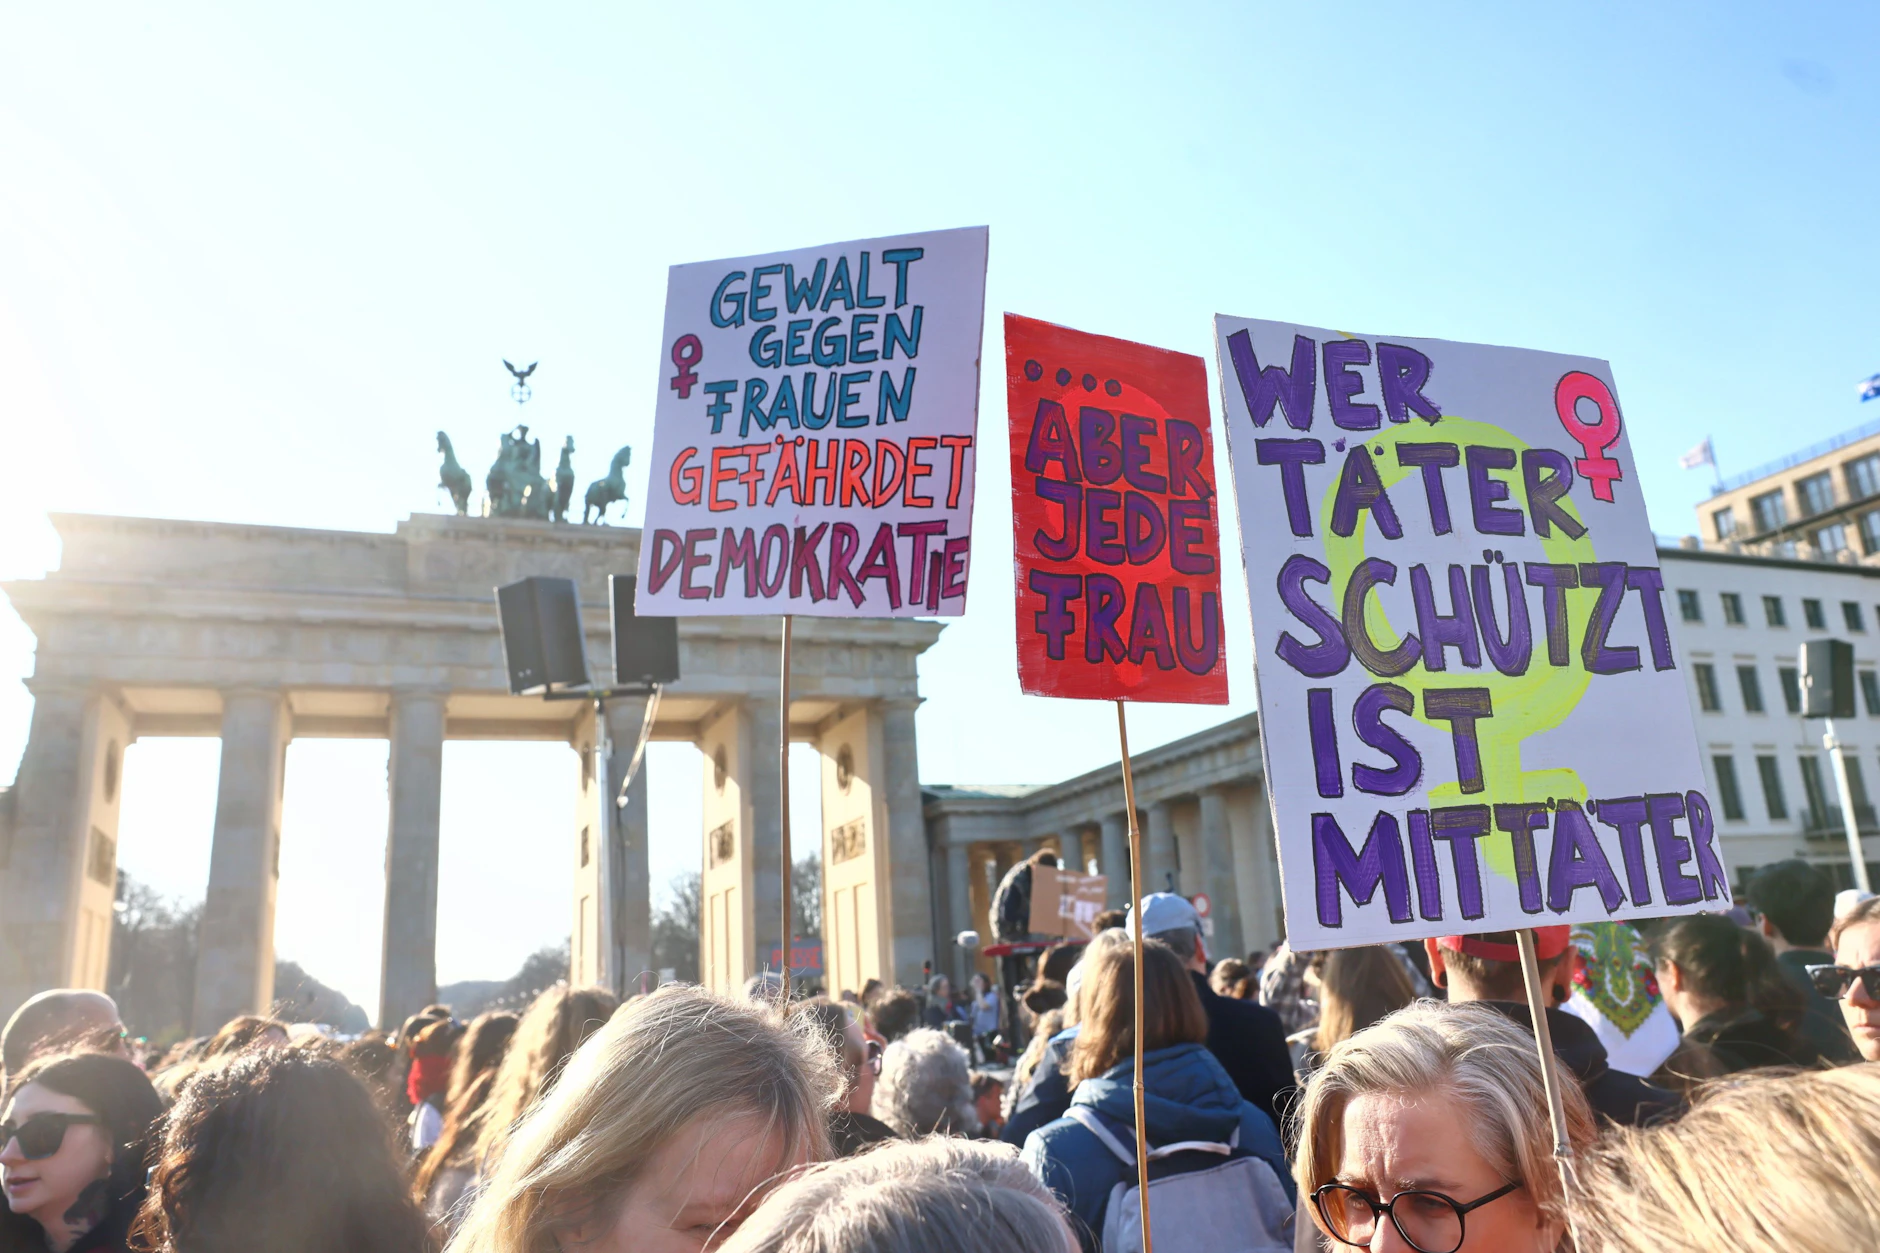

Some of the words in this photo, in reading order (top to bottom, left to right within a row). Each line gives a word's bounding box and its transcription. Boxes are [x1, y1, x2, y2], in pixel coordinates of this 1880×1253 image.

[710, 248, 924, 328] GEWALT
[749, 305, 924, 368] GEGEN
[704, 367, 917, 437] FRAUEN
[1227, 328, 1442, 431] WER
[669, 435, 973, 512] GEFÄHRDET
[1025, 398, 1214, 499] ABER
[1255, 437, 1588, 541] TÄTER
[648, 519, 970, 611] DEMOKRATIE
[1033, 477, 1215, 575] JEDE
[1029, 568, 1218, 675] FRAU
[1275, 549, 1676, 678] SCHÜTZT
[1307, 683, 1492, 798] IST
[1311, 790, 1731, 928] MITTÄTER
